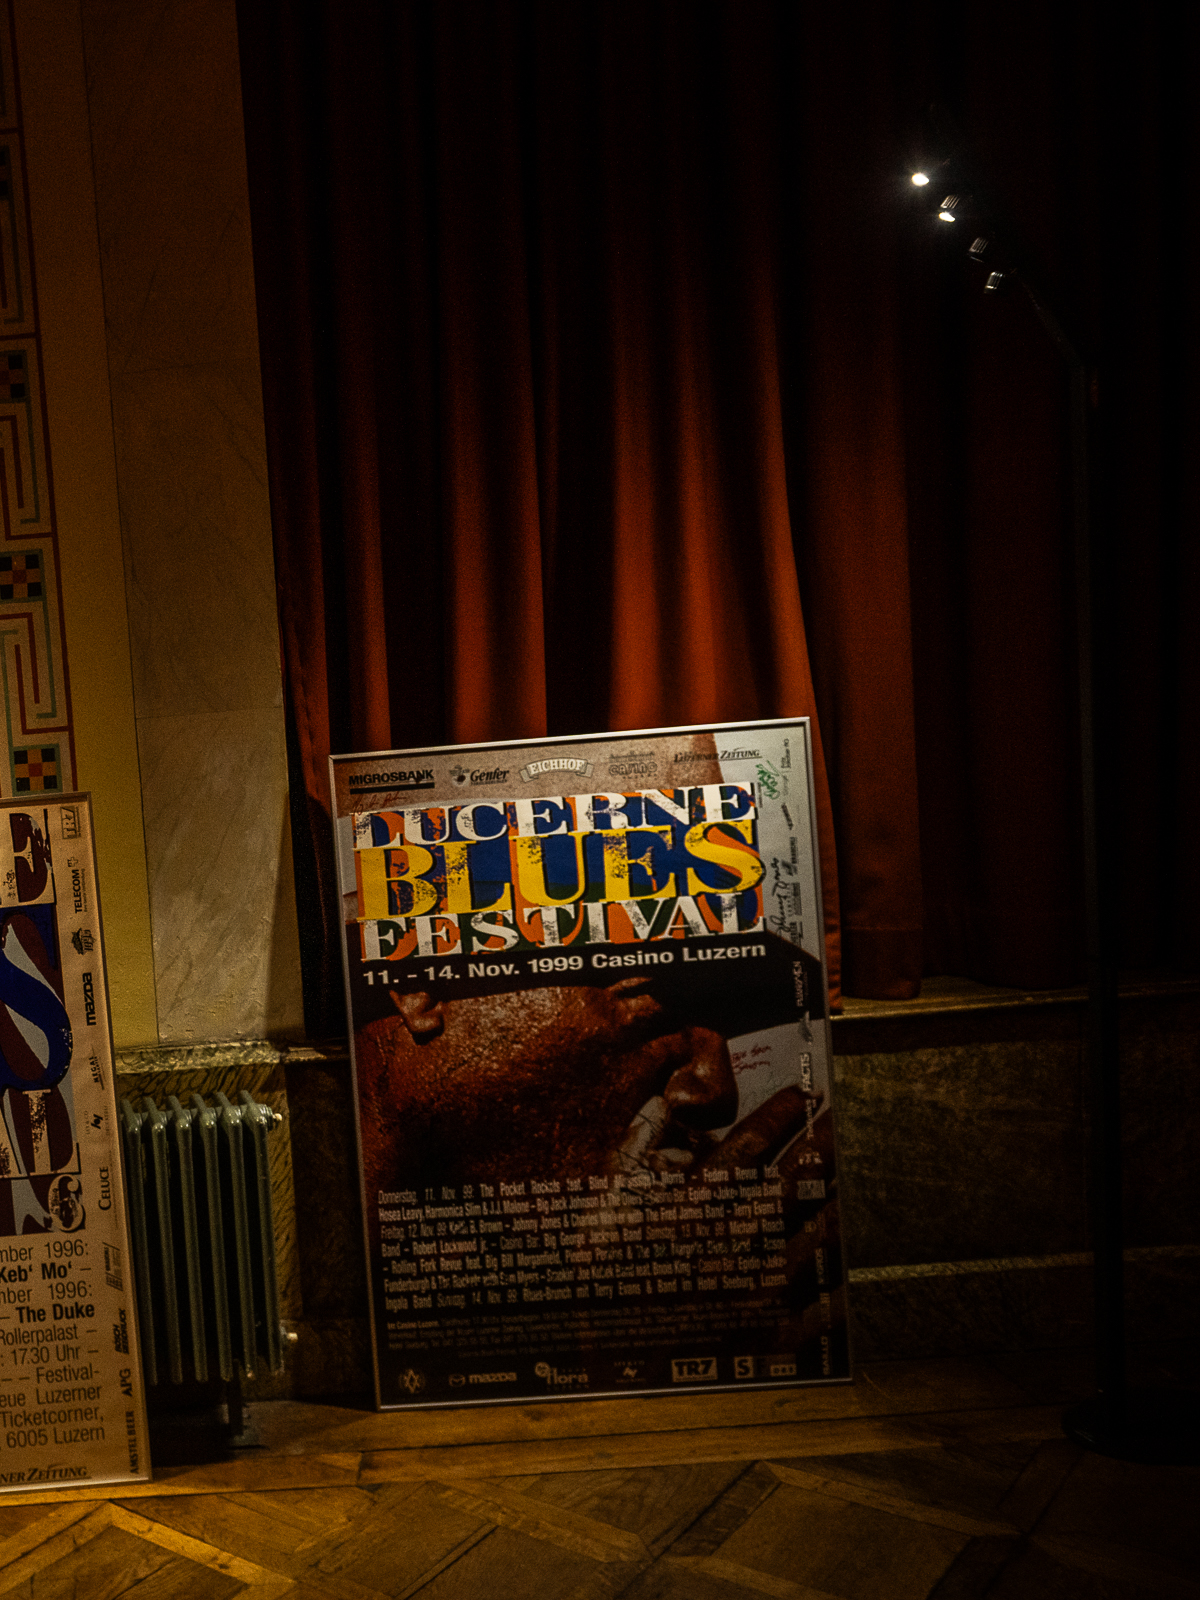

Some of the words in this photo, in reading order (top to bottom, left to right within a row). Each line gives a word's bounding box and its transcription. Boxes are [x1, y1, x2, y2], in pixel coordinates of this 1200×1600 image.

[349, 769, 434, 785] MIGROSBANK
[470, 767, 509, 782] Genfer
[530, 758, 585, 775] EICHHOF
[351, 782, 757, 849] LUCERNE
[356, 820, 767, 921] BLUES
[71, 869, 84, 914] TELECOM
[361, 892, 767, 961] FESTIVAL
[362, 969, 399, 985] 11.
[423, 964, 460, 980] 14.
[467, 962, 519, 977] Nov.
[527, 955, 583, 973] 1999
[591, 950, 674, 968] Casino
[682, 944, 765, 961] Luzern
[82, 972, 97, 1026] mazda
[44, 1238, 88, 1258] 1996:
[48, 1280, 92, 1299] 1996:
[15, 1305, 46, 1323] The
[52, 1301, 94, 1320] Duke
[10, 1344, 50, 1365] 17.30
[54, 1343, 80, 1362] Uhr
[35, 1362, 99, 1383] Festival-
[674, 1359, 714, 1377] TR7
[119, 1368, 133, 1397] APG
[35, 1385, 102, 1405] Luzerner
[5, 1427, 48, 1448] 6005
[52, 1420, 105, 1444] Luzern
[126, 1411, 135, 1437] BEER
[27, 1466, 88, 1481] ZEITUNG
